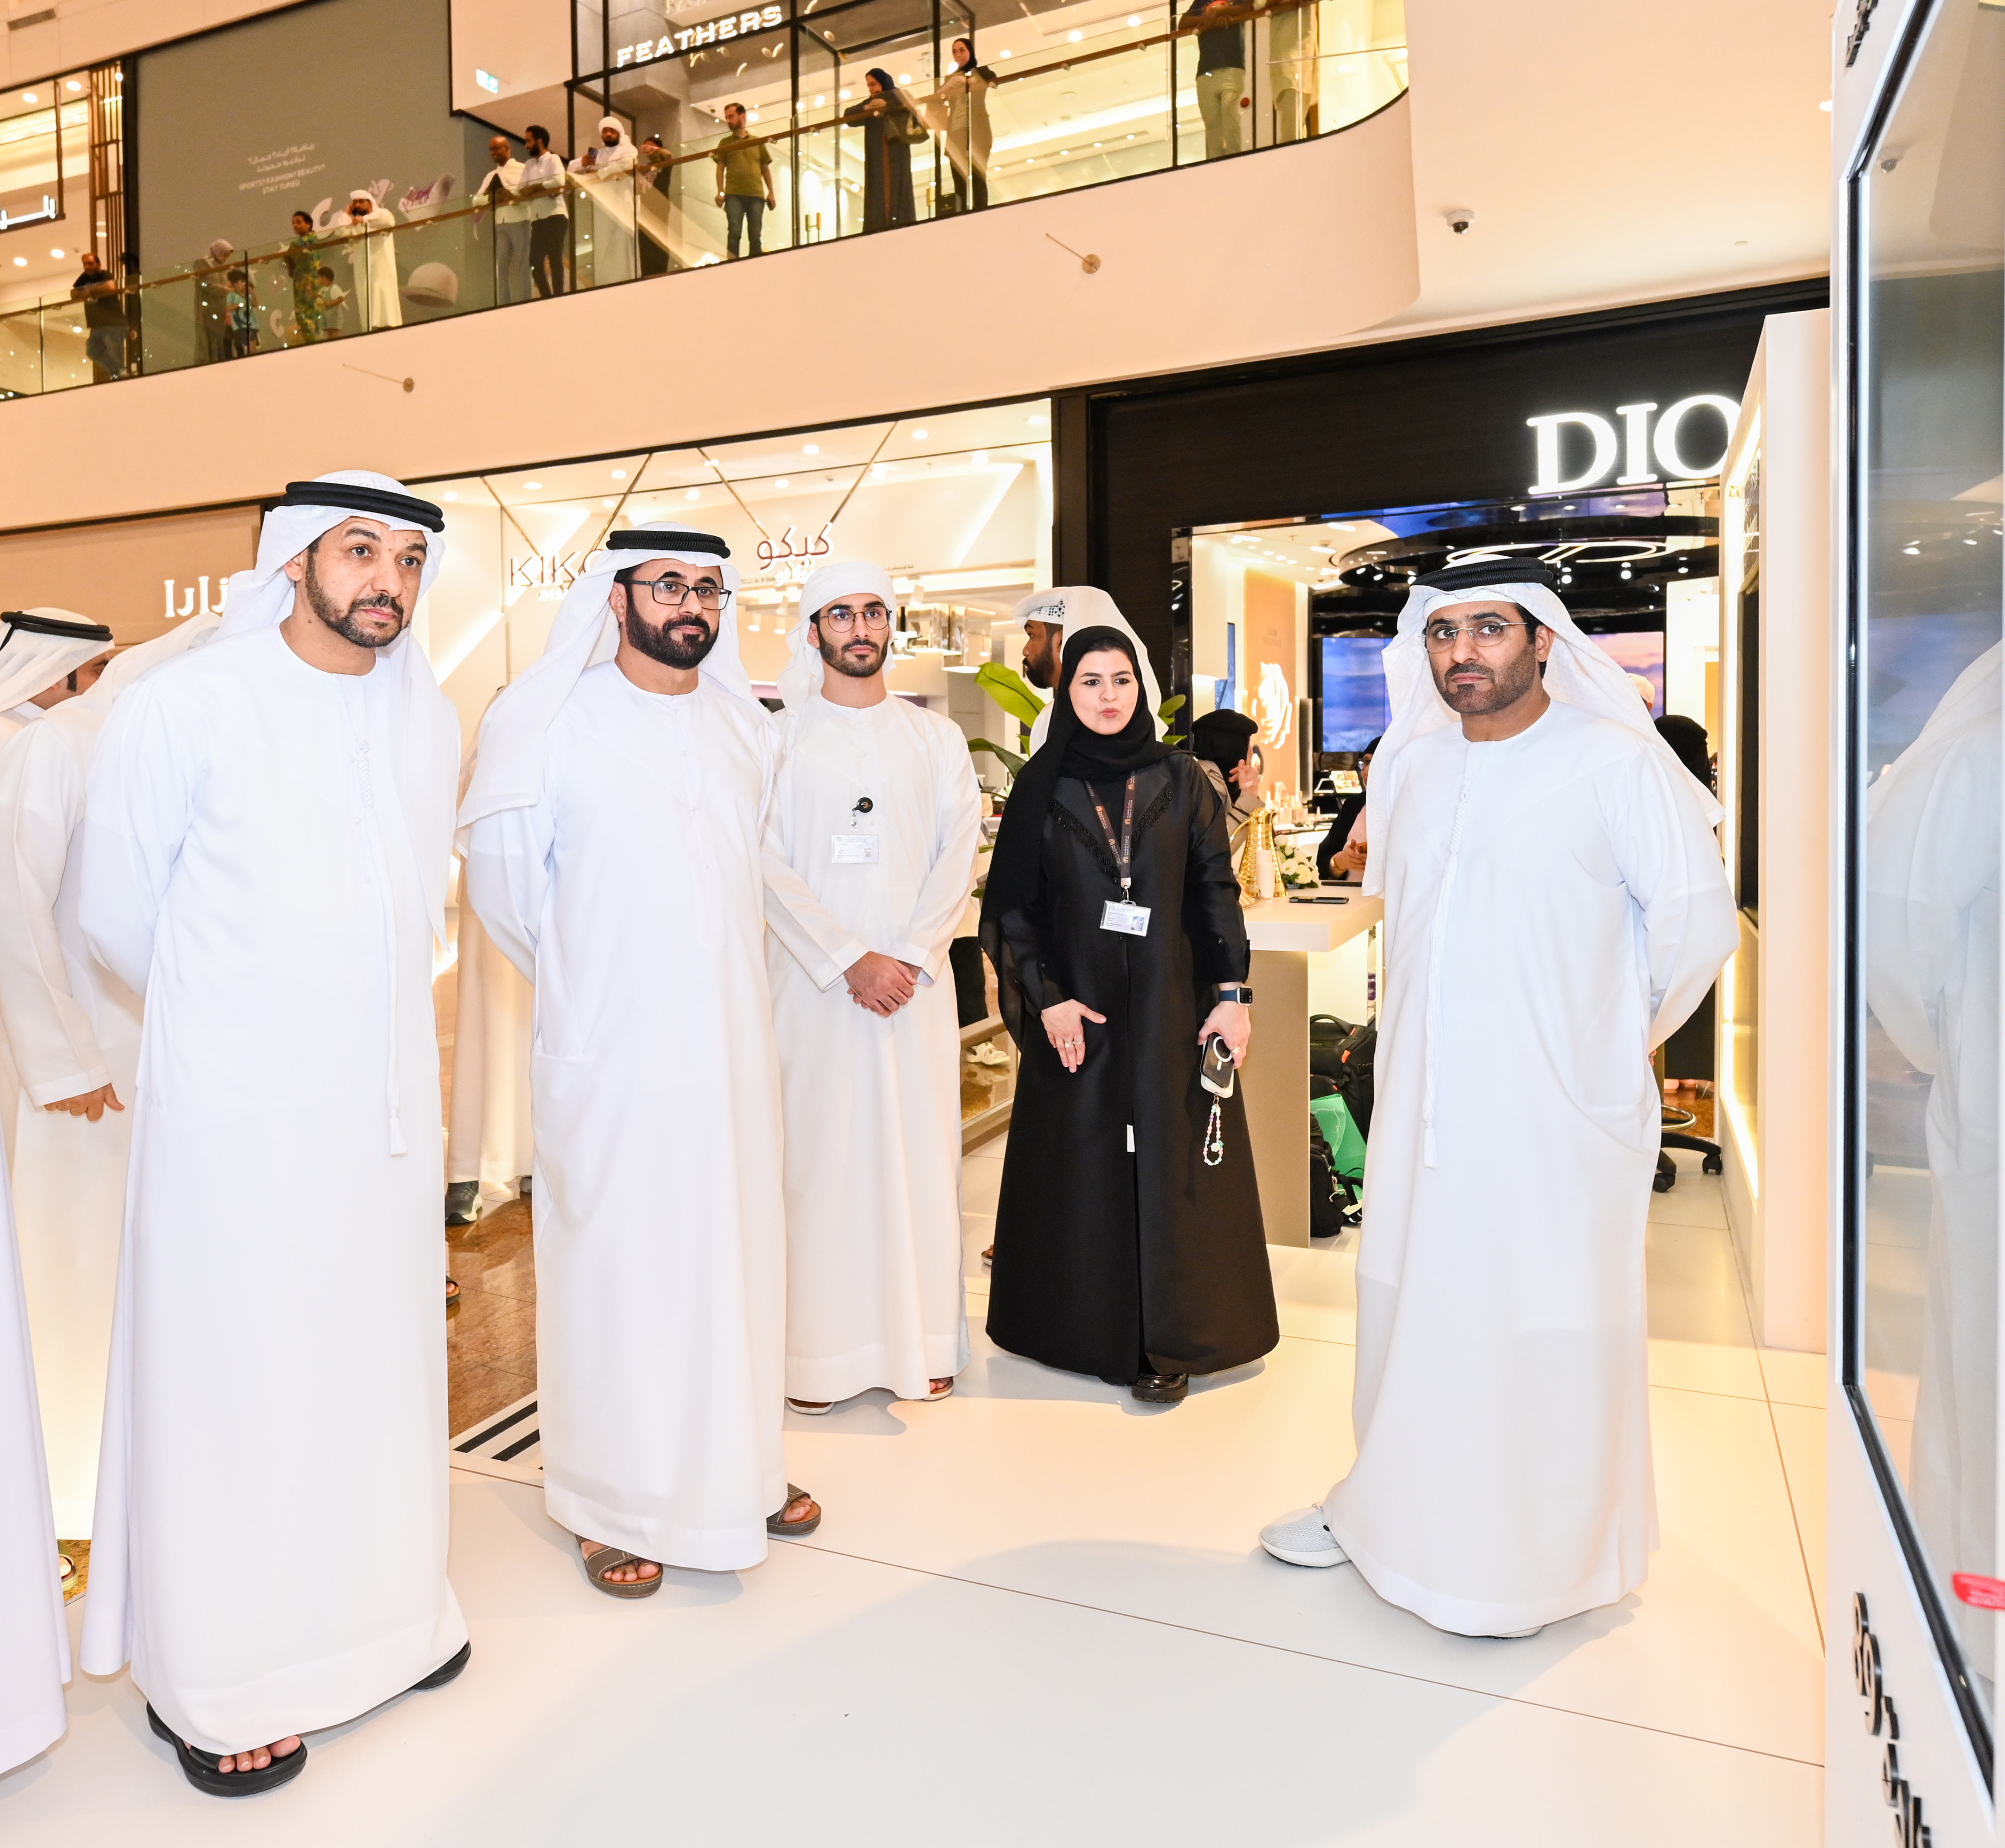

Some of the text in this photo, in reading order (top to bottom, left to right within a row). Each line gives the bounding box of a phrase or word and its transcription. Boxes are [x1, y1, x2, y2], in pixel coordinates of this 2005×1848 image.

[617, 6, 782, 68] FEATHERS
[757, 523, 833, 573] كيكو
[164, 576, 229, 618] زارا
